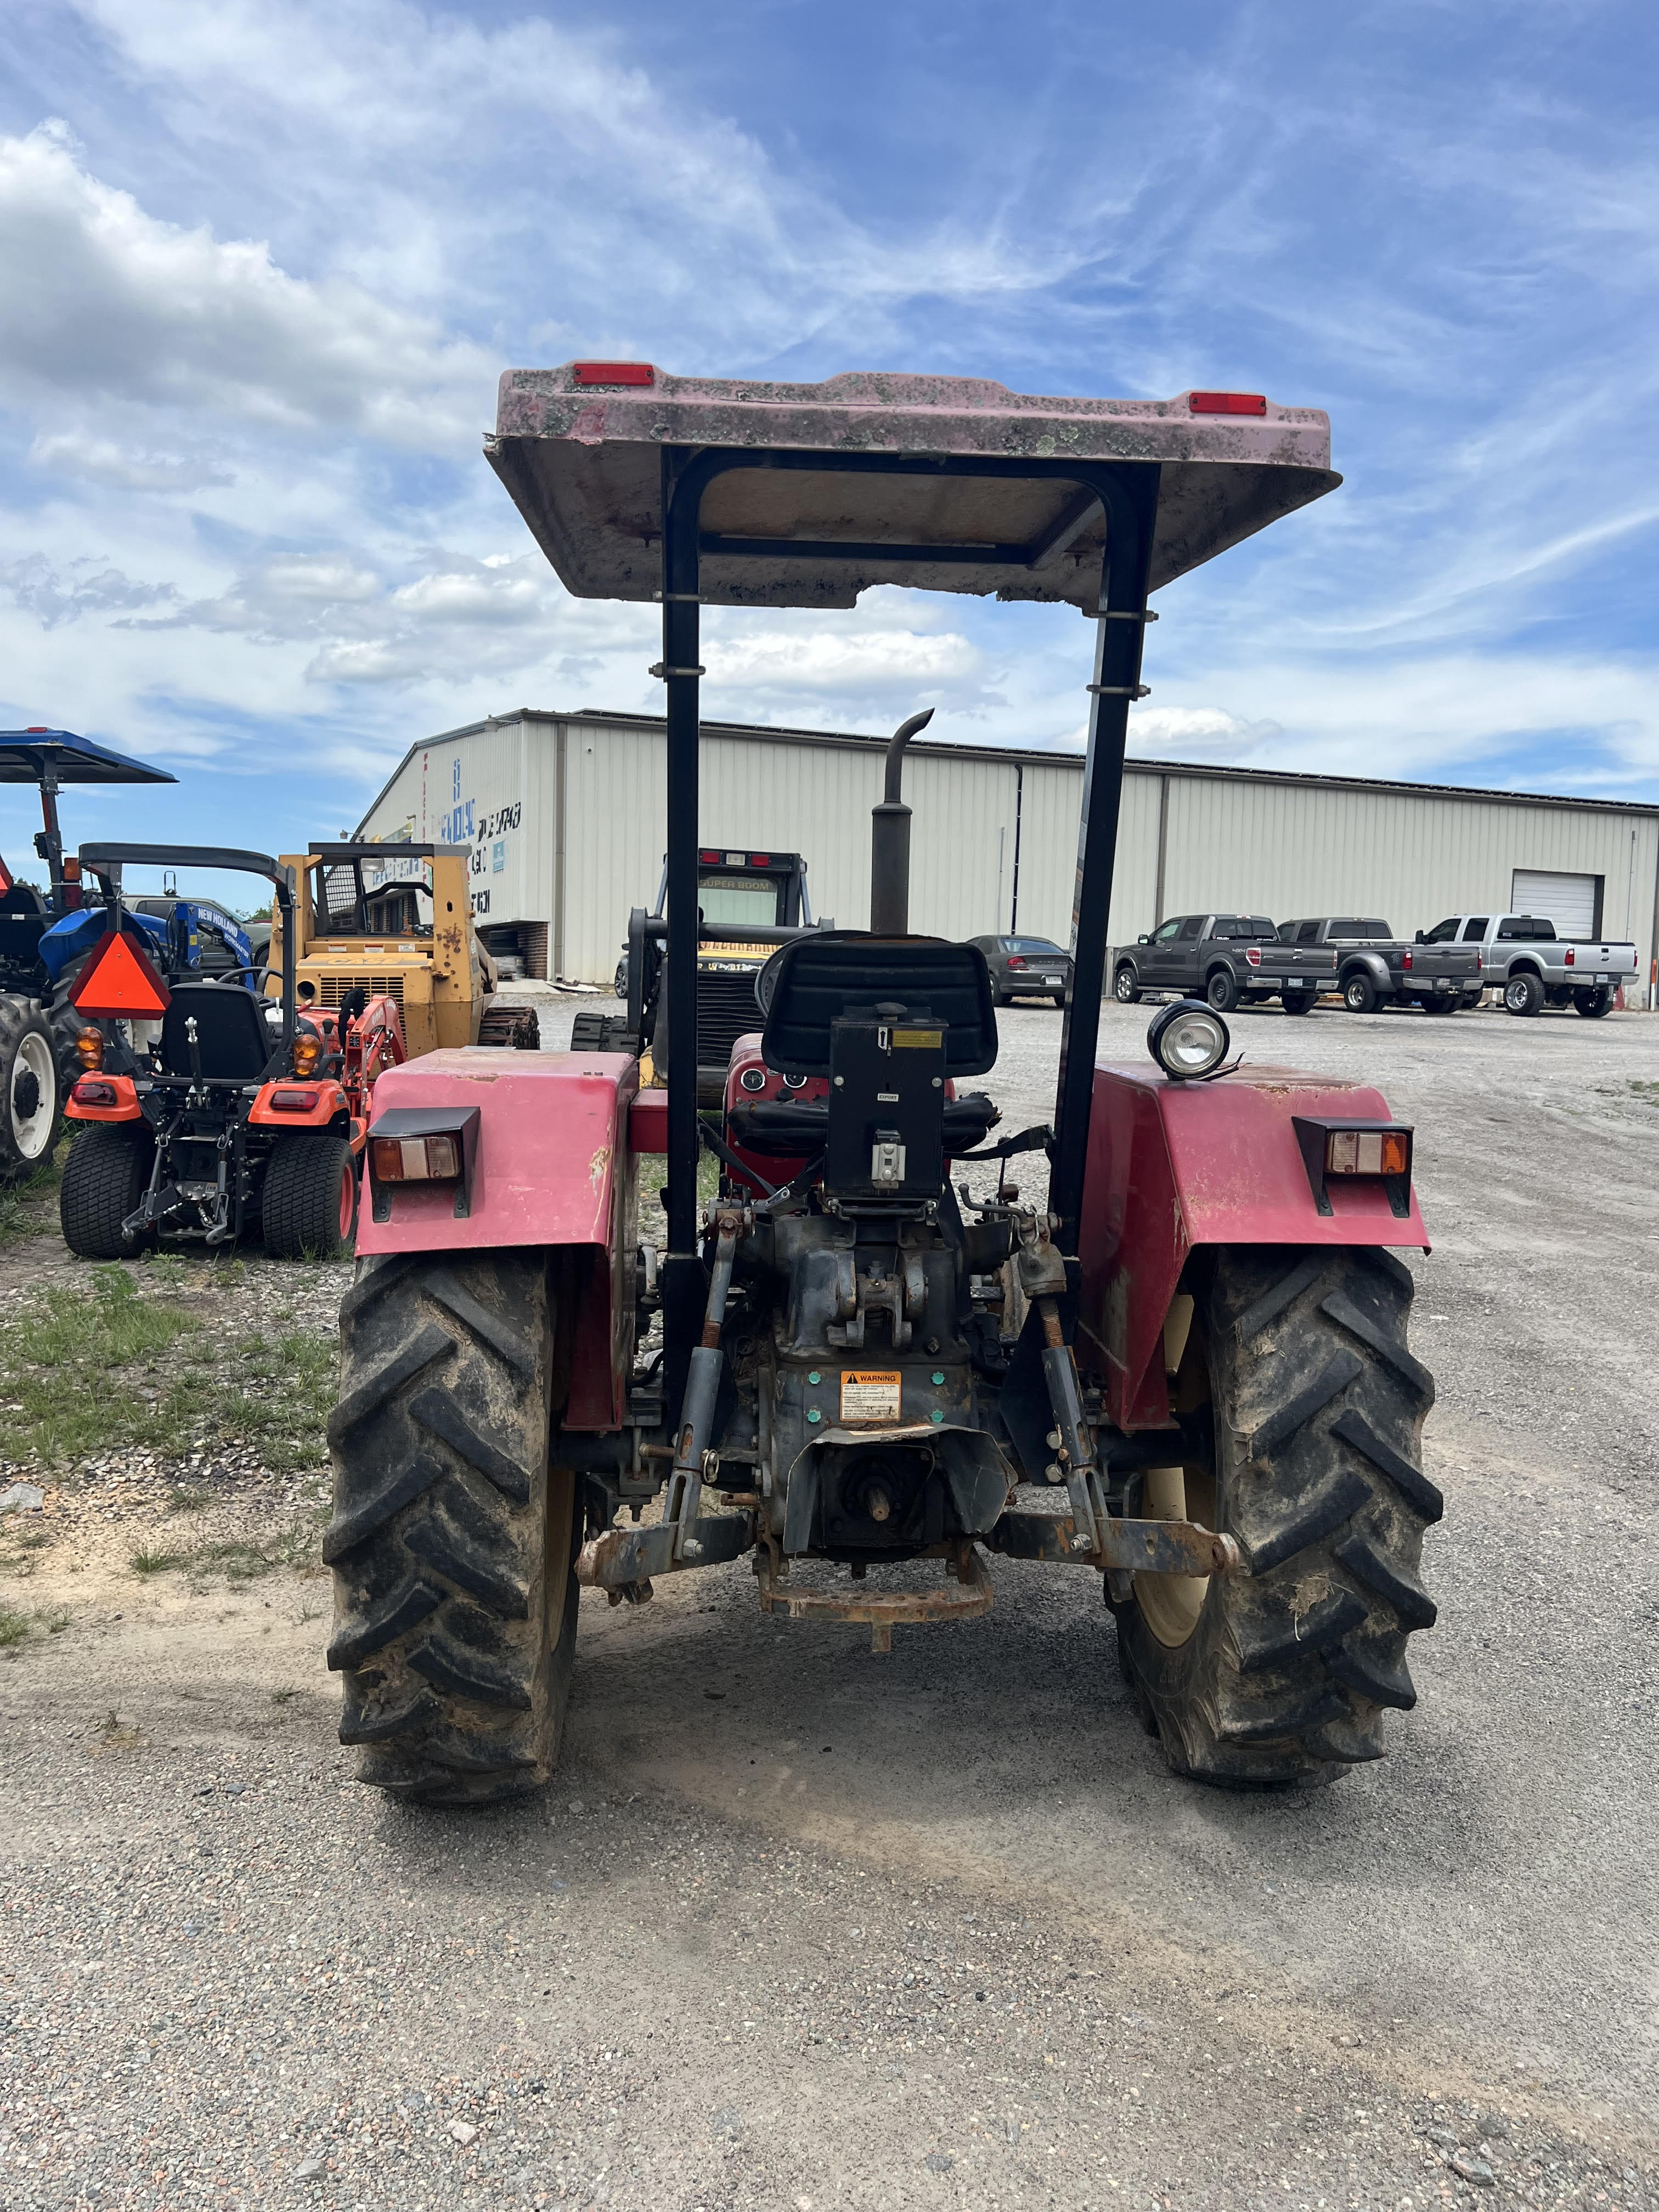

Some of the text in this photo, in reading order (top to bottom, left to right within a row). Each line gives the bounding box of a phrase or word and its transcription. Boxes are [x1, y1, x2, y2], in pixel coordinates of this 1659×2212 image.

[699, 879, 769, 890] SUPER BOOM
[198, 907, 238, 938] NEW HOLLAND
[224, 932, 249, 958] WORKMASTER
[327, 957, 404, 966] CASE
